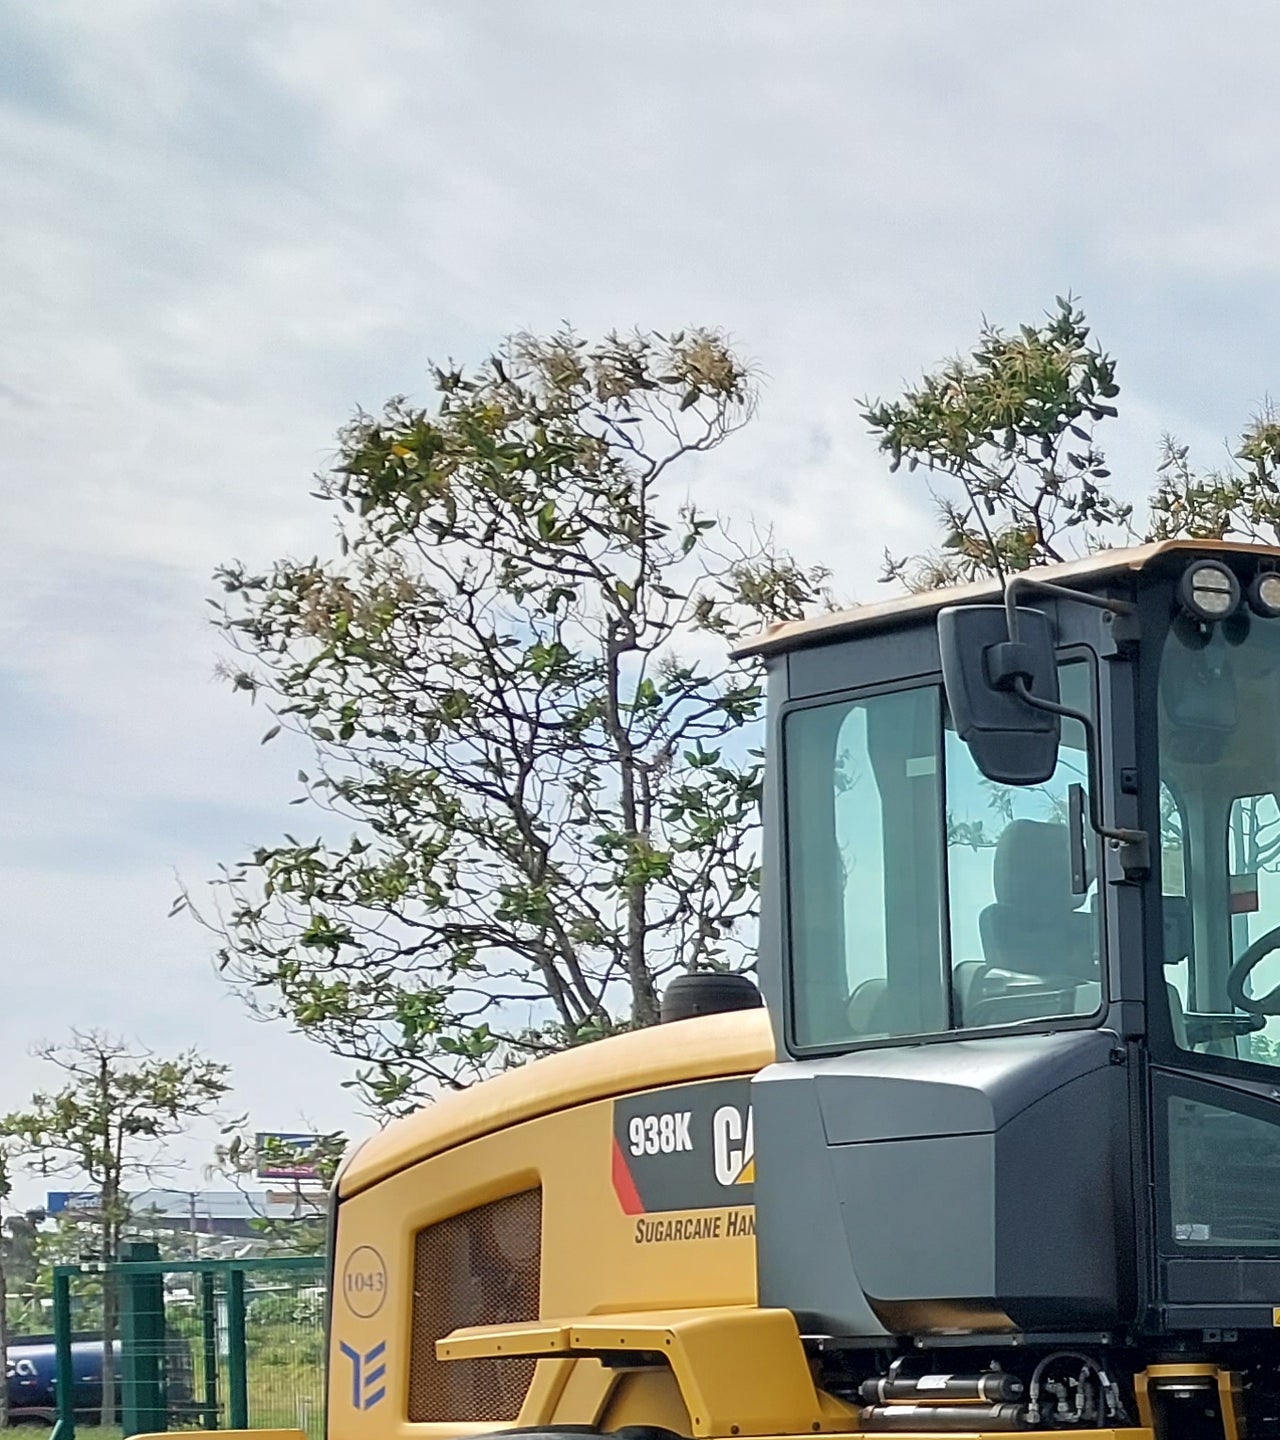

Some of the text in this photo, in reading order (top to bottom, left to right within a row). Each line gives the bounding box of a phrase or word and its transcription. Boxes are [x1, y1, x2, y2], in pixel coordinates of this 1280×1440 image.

[629, 1112, 693, 1157] 938K
[635, 1215, 721, 1244] SUGARCANE
[346, 1272, 384, 1292] 1043
